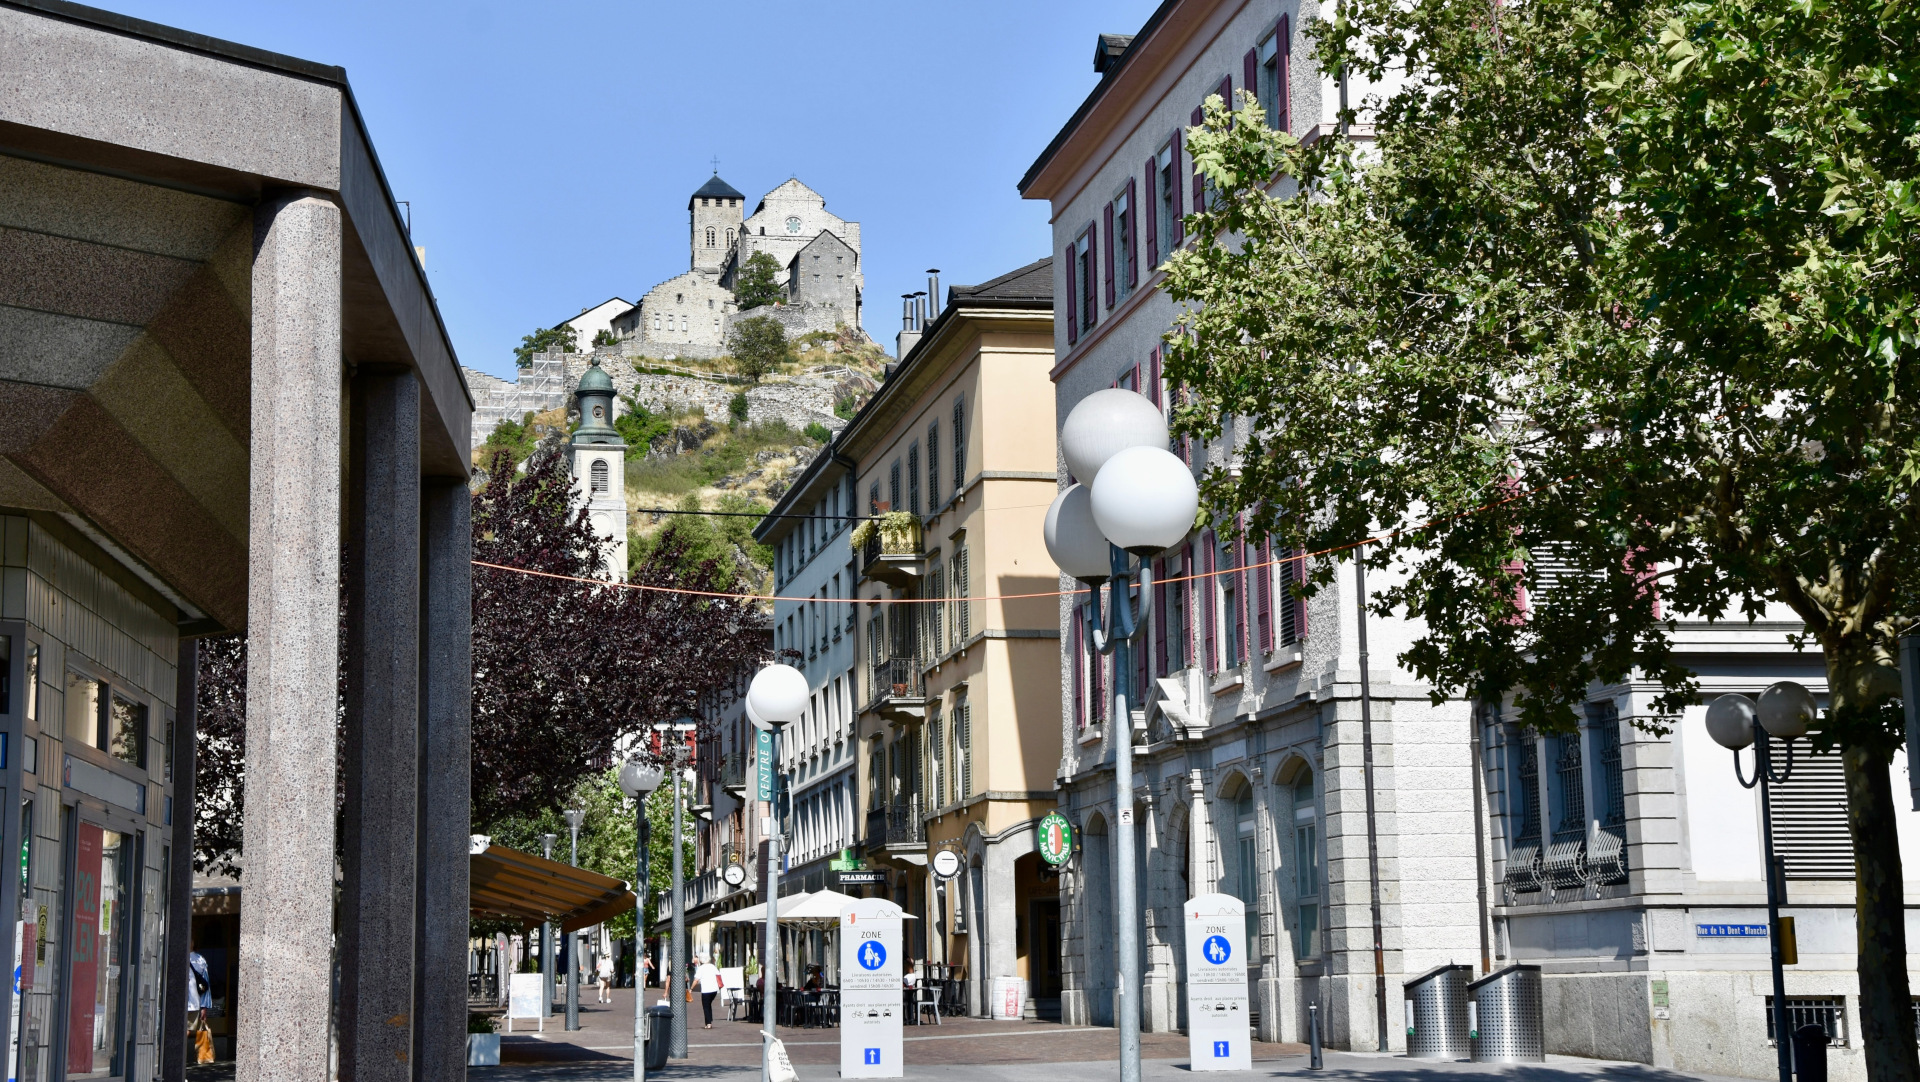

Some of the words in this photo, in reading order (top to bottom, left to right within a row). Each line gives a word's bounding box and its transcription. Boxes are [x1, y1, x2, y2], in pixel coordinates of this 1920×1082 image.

[760, 750, 770, 799] CENTRE
[1041, 816, 1068, 830] POLICE
[1040, 841, 1070, 863] MUNICIPALE
[861, 931, 882, 939] ZONE
[1206, 925, 1226, 934] ZONE
[1697, 926, 1708, 935] Rue
[1710, 926, 1717, 935] de
[1719, 926, 1725, 935] la
